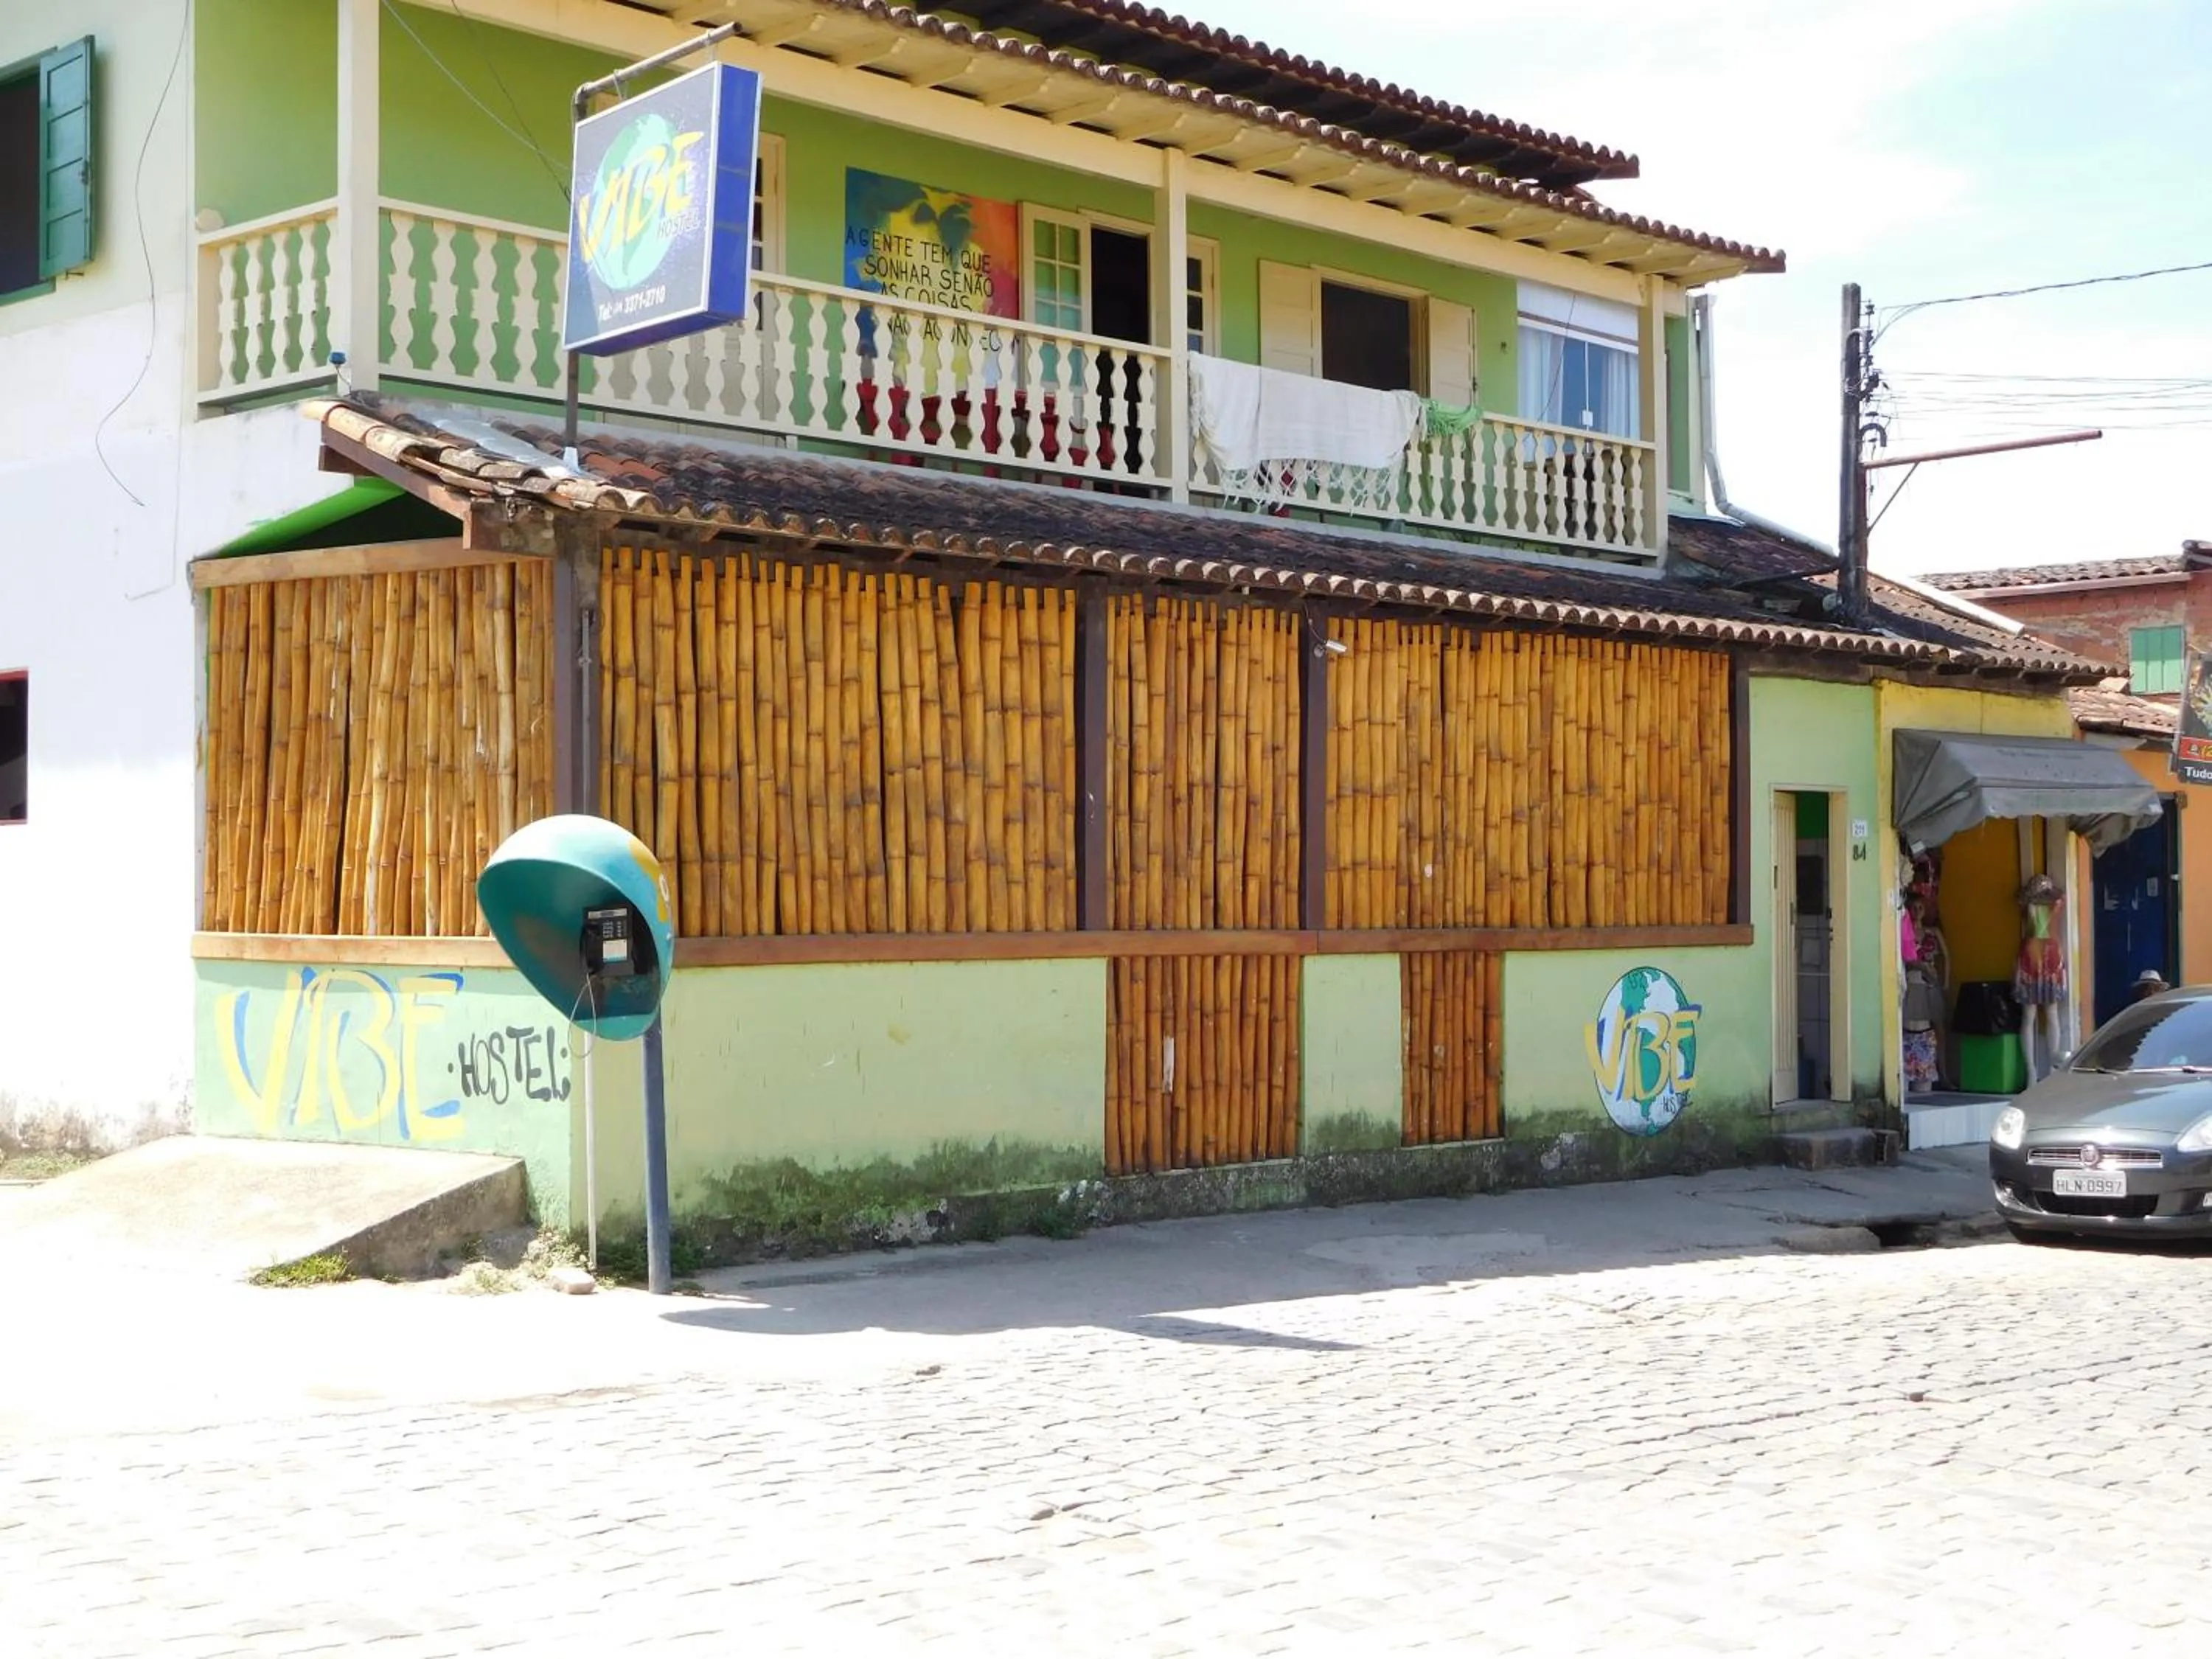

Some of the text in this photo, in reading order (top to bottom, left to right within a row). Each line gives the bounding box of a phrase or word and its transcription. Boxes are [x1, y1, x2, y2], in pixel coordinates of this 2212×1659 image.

[578, 131, 706, 264] VIBE
[864, 254, 994, 297] SONHAR SENÃO
[919, 240, 953, 265] TEM
[961, 249, 991, 274] QUE
[1853, 842, 1866, 861] 84
[214, 966, 465, 1141] VIBE
[1584, 1004, 1703, 1102] VIBE
